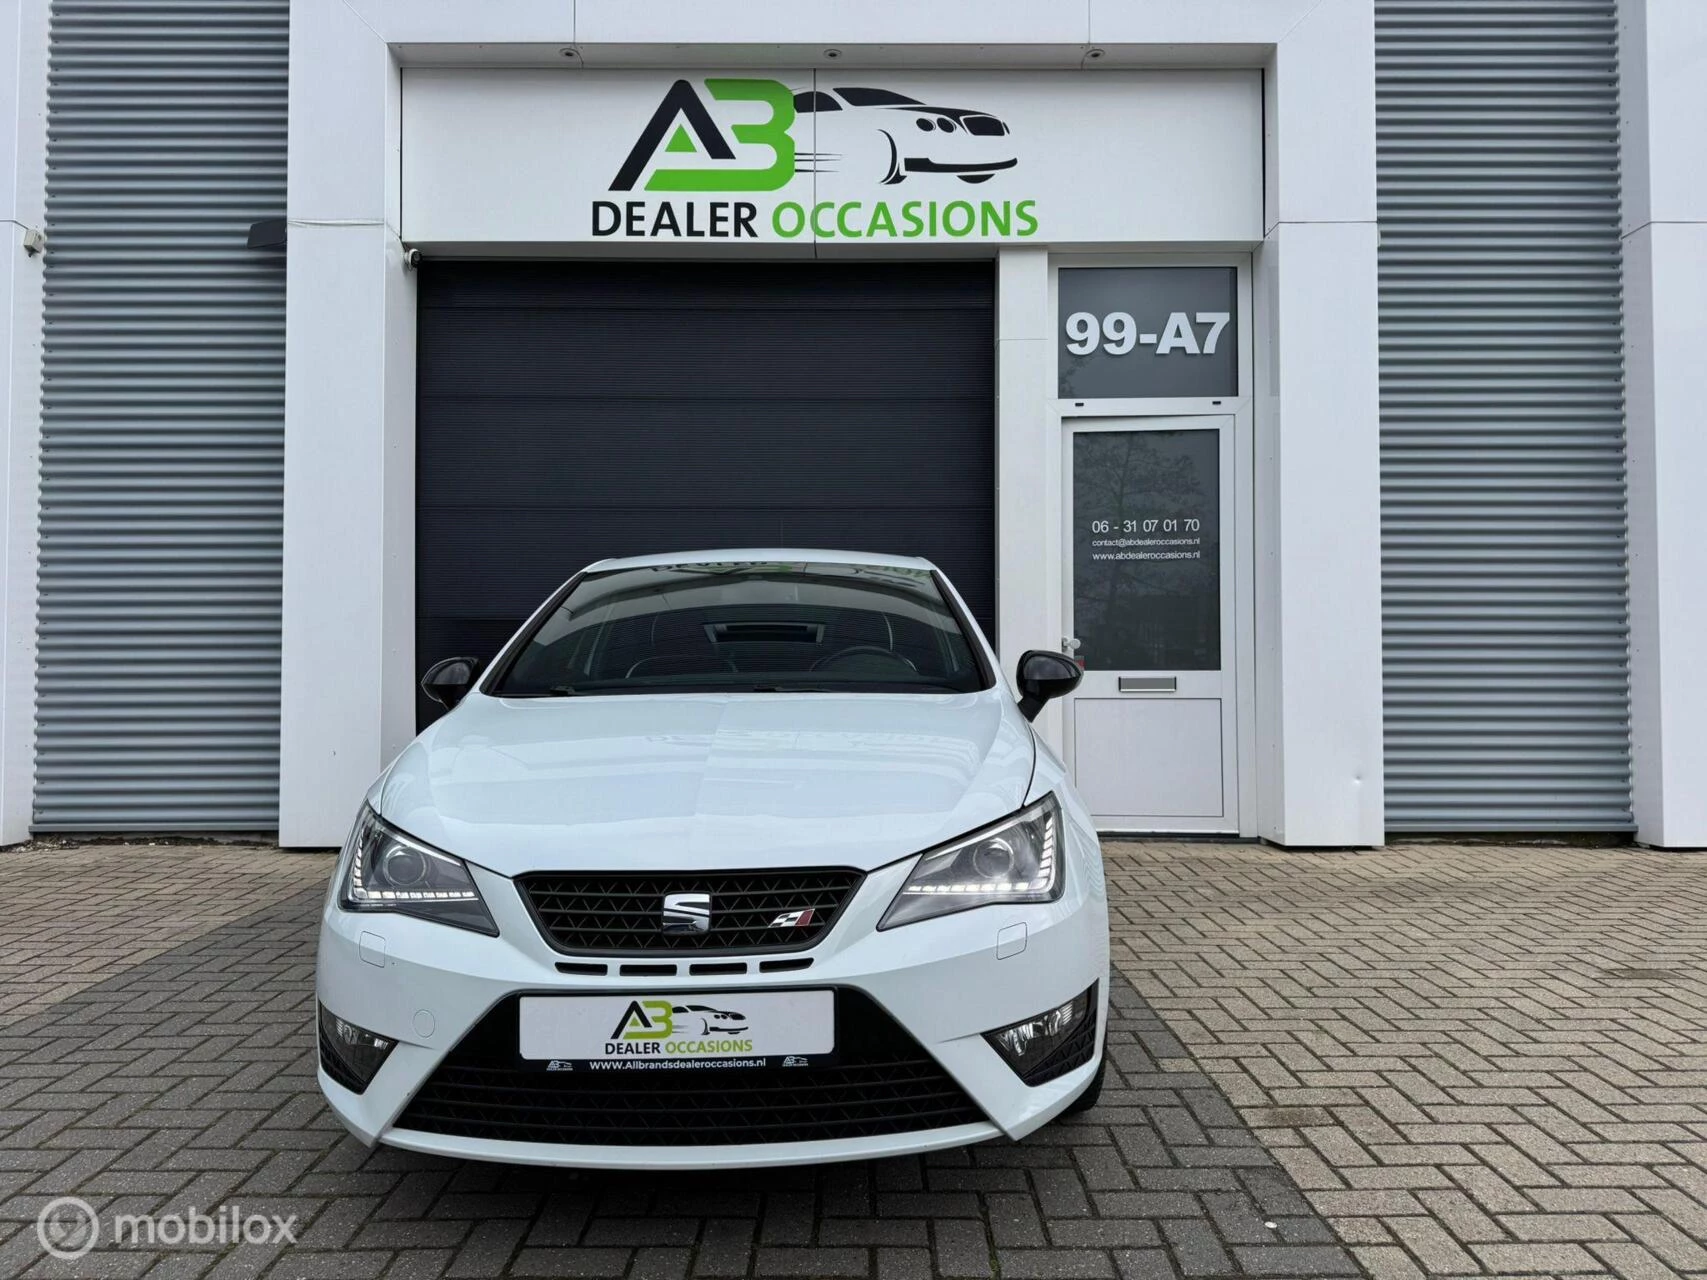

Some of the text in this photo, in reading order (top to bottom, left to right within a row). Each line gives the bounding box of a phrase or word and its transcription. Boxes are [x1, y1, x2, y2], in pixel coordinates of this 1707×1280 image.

[592, 200, 1038, 238] DEALER OCCASIONS
[1065, 311, 1231, 356] 99-A7
[1092, 520, 1109, 533] 06
[1123, 520, 1137, 533] 31
[1143, 519, 1159, 533] 07
[1163, 519, 1177, 532] 01
[1184, 519, 1200, 532] 70
[1092, 538, 1200, 547] contact@abdealeroccasions.nl
[1092, 550, 1201, 560] www.abdealeroccasions.nl
[605, 1040, 753, 1055] DEALER OCCASIONS
